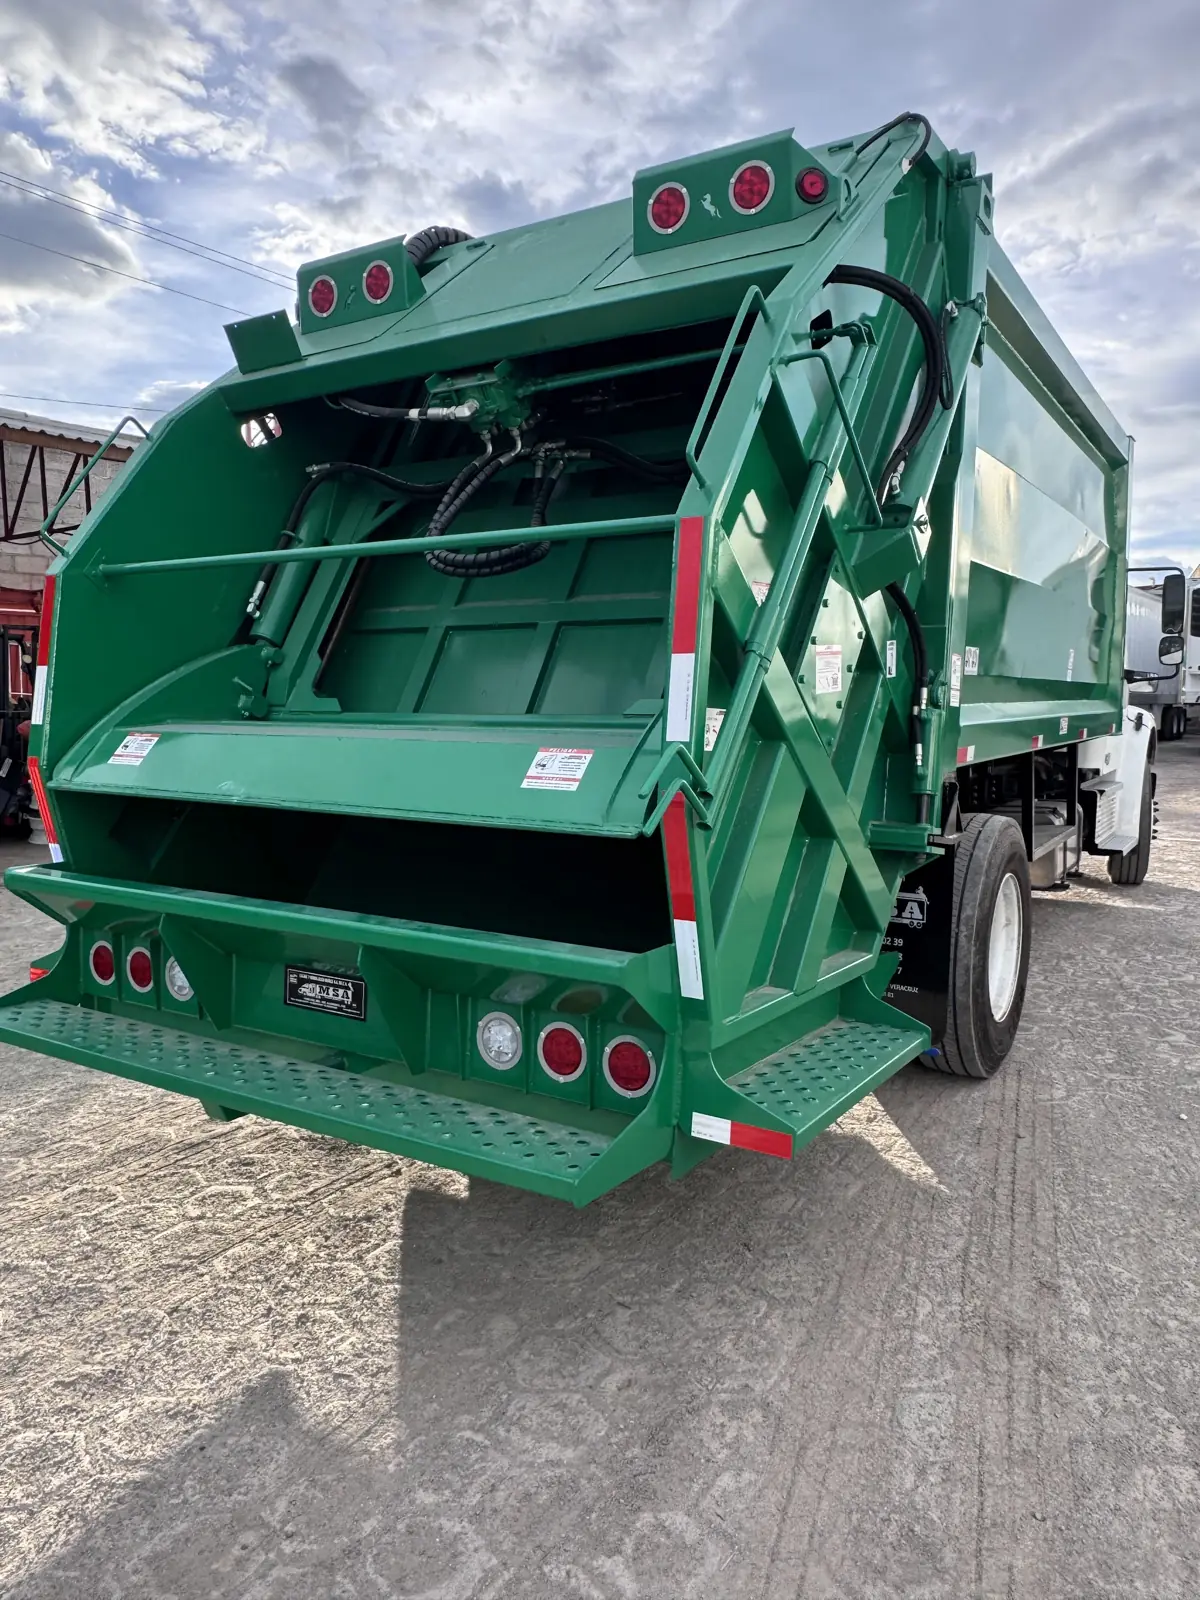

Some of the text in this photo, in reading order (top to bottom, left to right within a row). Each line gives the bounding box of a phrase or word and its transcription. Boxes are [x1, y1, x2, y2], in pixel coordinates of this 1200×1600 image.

[893, 938, 903, 946] 39
[318, 985, 350, 999] MSA
[889, 984, 919, 993] VERACRUZ
